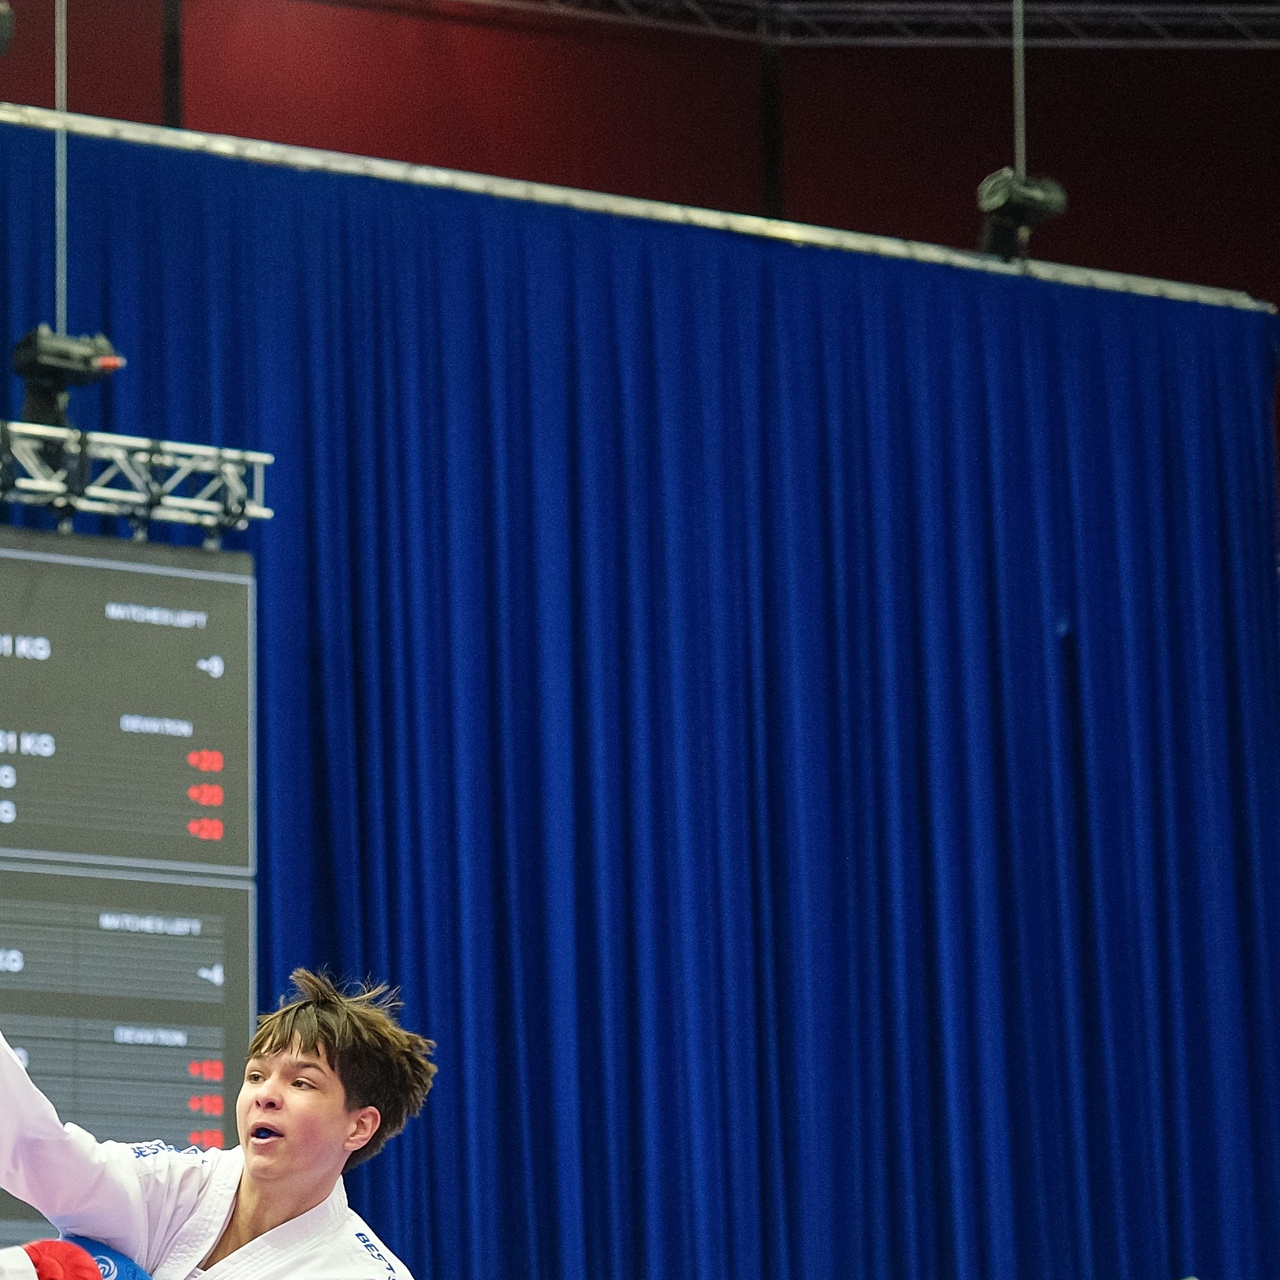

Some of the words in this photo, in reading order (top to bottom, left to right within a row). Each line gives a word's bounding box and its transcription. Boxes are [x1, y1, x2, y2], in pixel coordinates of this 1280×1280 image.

[14, 634, 52, 661] KG
[19, 732, 56, 757] KG
[355, 1232, 396, 1274] BEST
